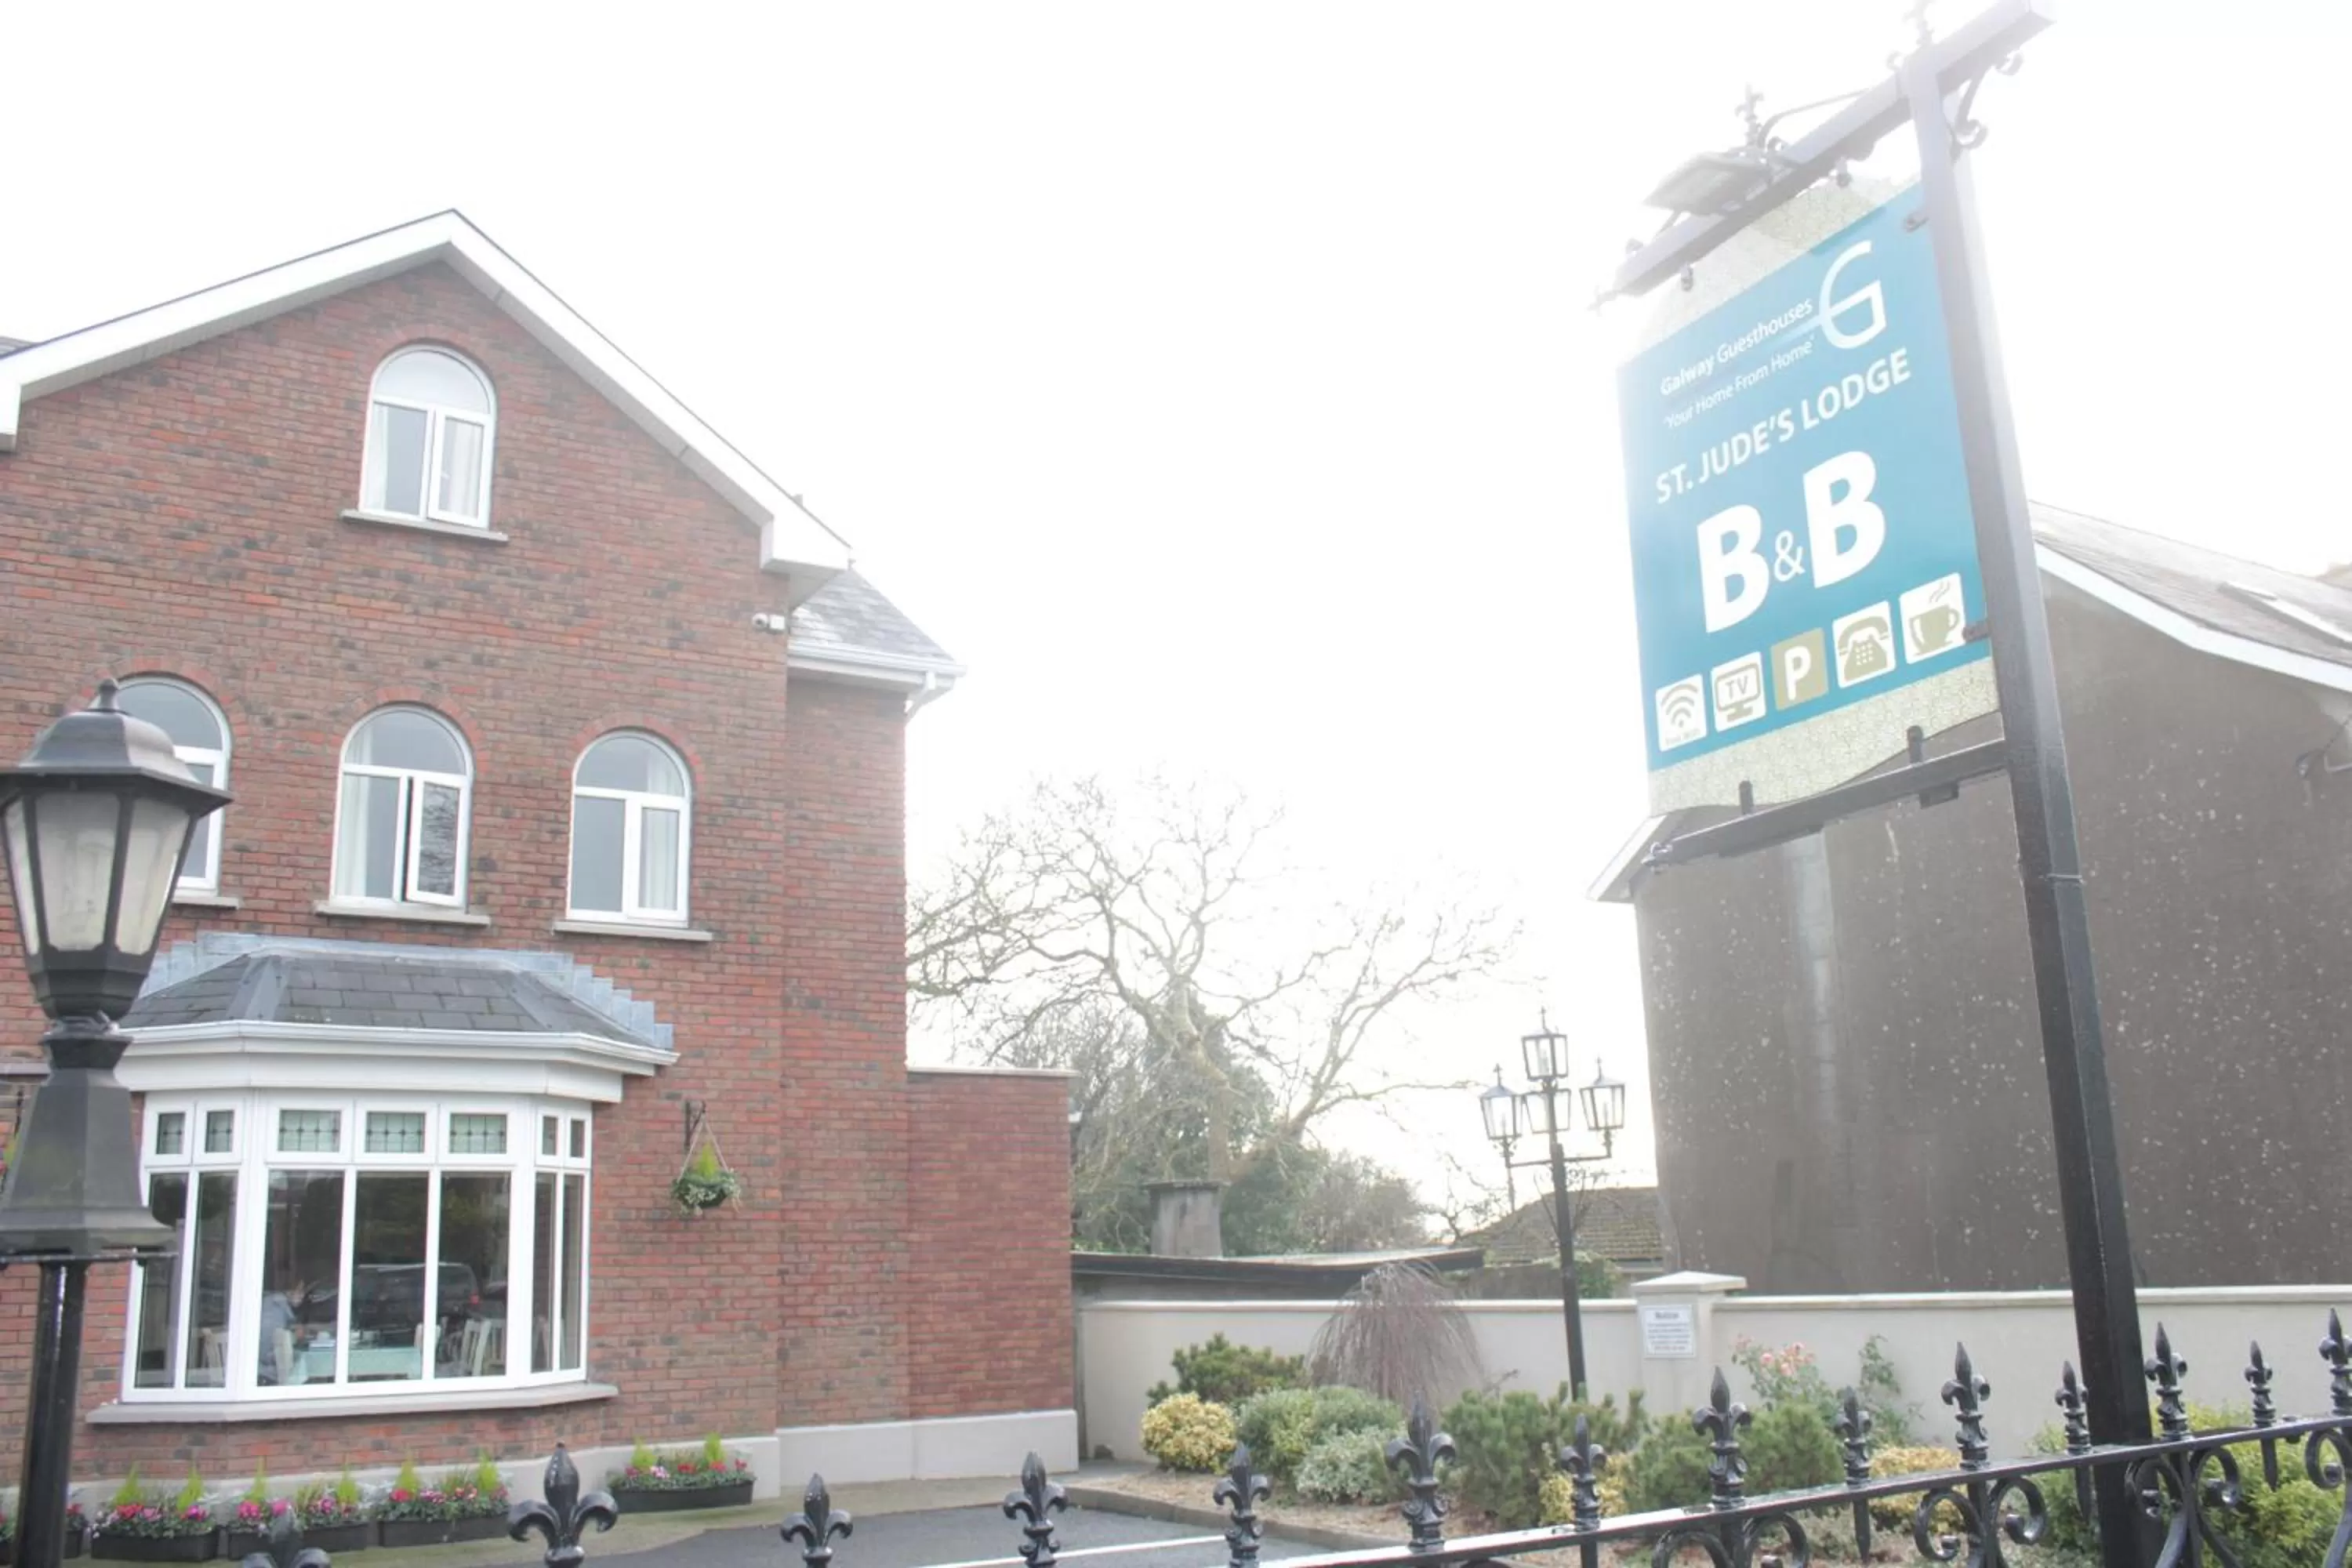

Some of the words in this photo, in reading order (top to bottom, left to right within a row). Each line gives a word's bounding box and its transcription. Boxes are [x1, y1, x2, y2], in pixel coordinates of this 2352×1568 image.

[1660, 354, 1715, 395] Galway
[1715, 298, 1813, 364] Guesthouses
[1695, 386, 1734, 414] Home
[1735, 364, 1769, 391] From
[1656, 463, 1693, 504] ST.
[1698, 408, 1795, 483] JUDE'S
[1801, 348, 1912, 430] LODGE
[1726, 674, 1748, 700] TV
[1784, 645, 1812, 701] P
